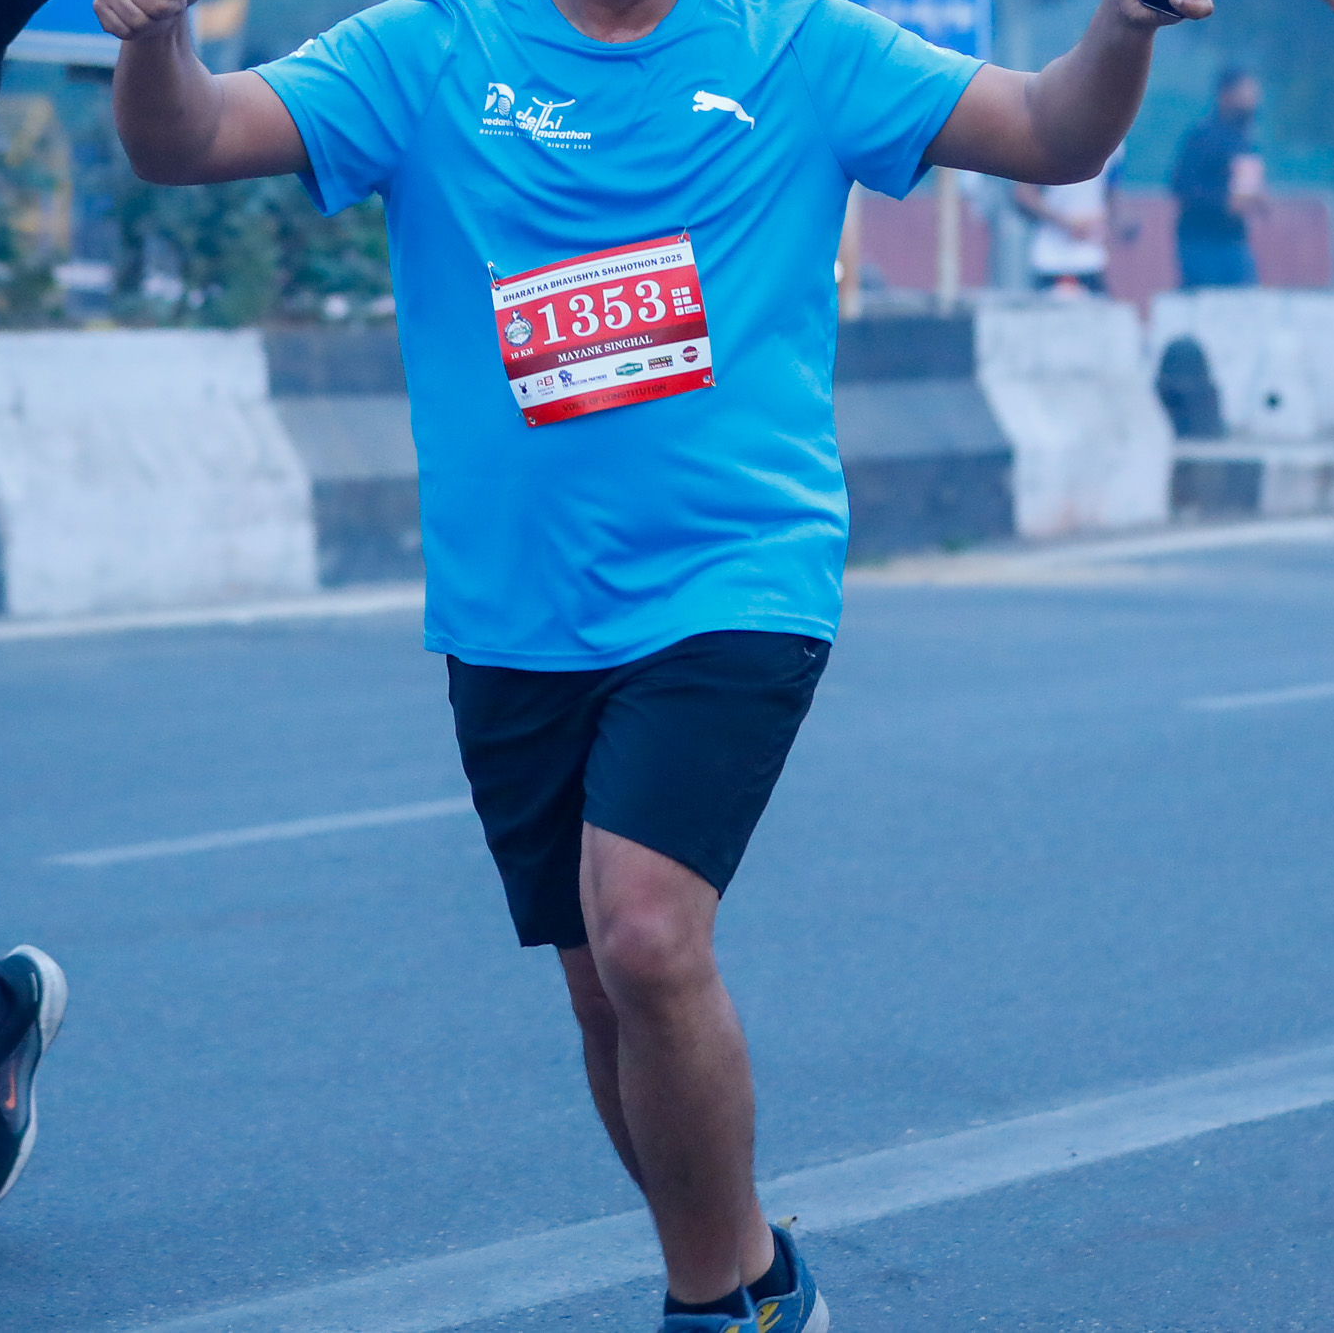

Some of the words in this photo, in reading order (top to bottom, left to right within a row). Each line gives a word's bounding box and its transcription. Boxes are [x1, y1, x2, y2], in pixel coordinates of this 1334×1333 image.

[537, 130, 592, 140] marathon
[502, 287, 536, 303] BHARAT
[537, 283, 549, 293] KA
[550, 270, 600, 289] BHAVISHYA
[601, 259, 658, 276] SHAHOTHON
[660, 253, 683, 265] 2025
[537, 279, 667, 346] 1353
[510, 351, 520, 360] 10
[520, 347, 534, 358] KM
[557, 344, 603, 364] MAYANK
[604, 335, 653, 352] SINGHAL
[602, 384, 667, 404] CONSTITUTION
